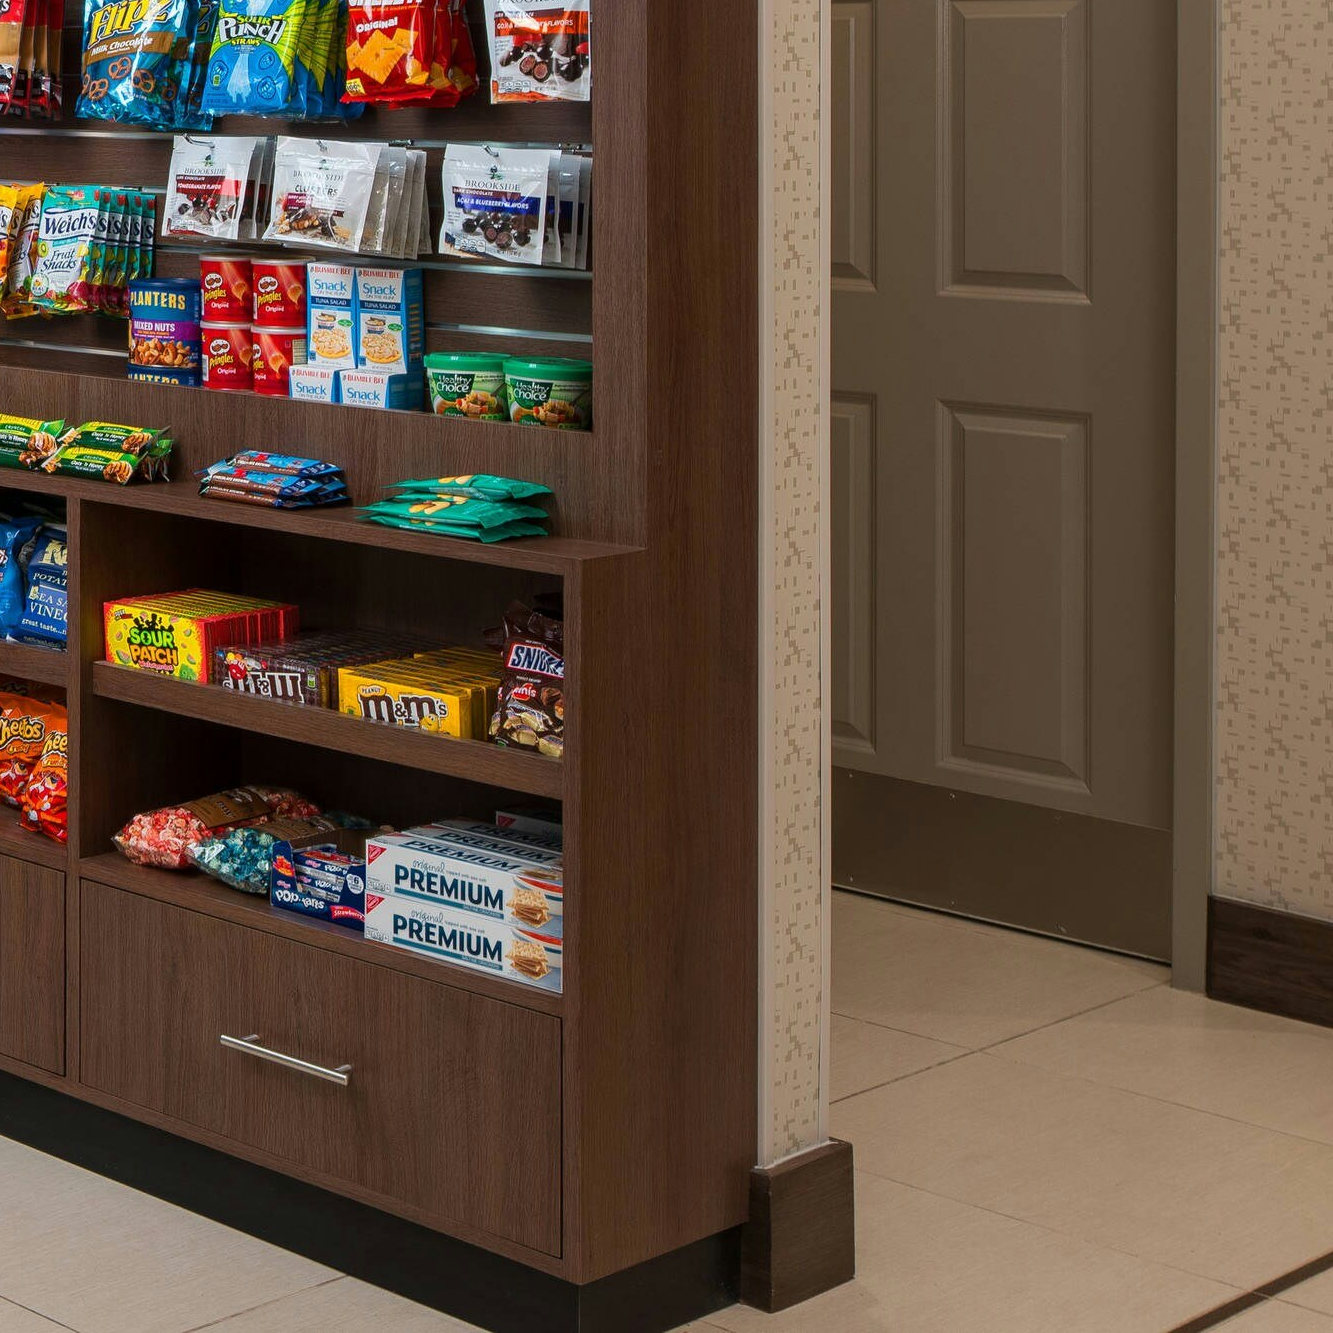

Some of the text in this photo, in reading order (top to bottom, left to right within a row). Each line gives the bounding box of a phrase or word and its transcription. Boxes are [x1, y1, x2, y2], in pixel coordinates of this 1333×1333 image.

[236, 14, 271, 26] SOUR
[218, 16, 288, 45] PUNCH
[90, 37, 154, 57] Milk Chocolate
[230, 37, 262, 46] STRAWS
[184, 167, 226, 175] BROOKSIDE
[453, 187, 494, 197] DARK CHOCOLATE
[465, 178, 522, 192] BROOKSIDE
[44, 212, 98, 236] Welch's
[51, 248, 76, 260] Fruit
[42, 258, 77, 273] Snacks
[340, 268, 352, 276] BEE
[314, 279, 347, 293] Snack
[362, 283, 397, 297] Snack
[130, 290, 187, 311] PLANTERS
[204, 288, 227, 301] Pringles
[257, 292, 282, 306] Pringles
[315, 297, 347, 306] TUNA SALAD
[364, 302, 397, 311] TUNA SALAD
[134, 320, 176, 332] MIXED NUTS
[209, 353, 235, 367] Pringles
[438, 373, 472, 386] Healthy
[295, 382, 327, 396] Snack
[347, 388, 381, 402] Snack
[436, 382, 470, 394] Choice
[513, 388, 548, 402] Choice
[516, 382, 550, 394] Healthy
[33, 572, 68, 586] POTAT
[129, 627, 175, 649] SOUR
[130, 646, 179, 666] PATCH
[510, 644, 565, 677] SNICK
[361, 687, 381, 695] PEANUT
[358, 695, 448, 727] m&m's
[437, 831, 558, 864] PREMIUM
[404, 839, 523, 872] PREMIUM
[413, 858, 445, 875] original
[394, 863, 504, 911] PREMIUM
[334, 909, 364, 920] Strawberry
[411, 908, 444, 925] original
[392, 913, 503, 963] PREMIUM
